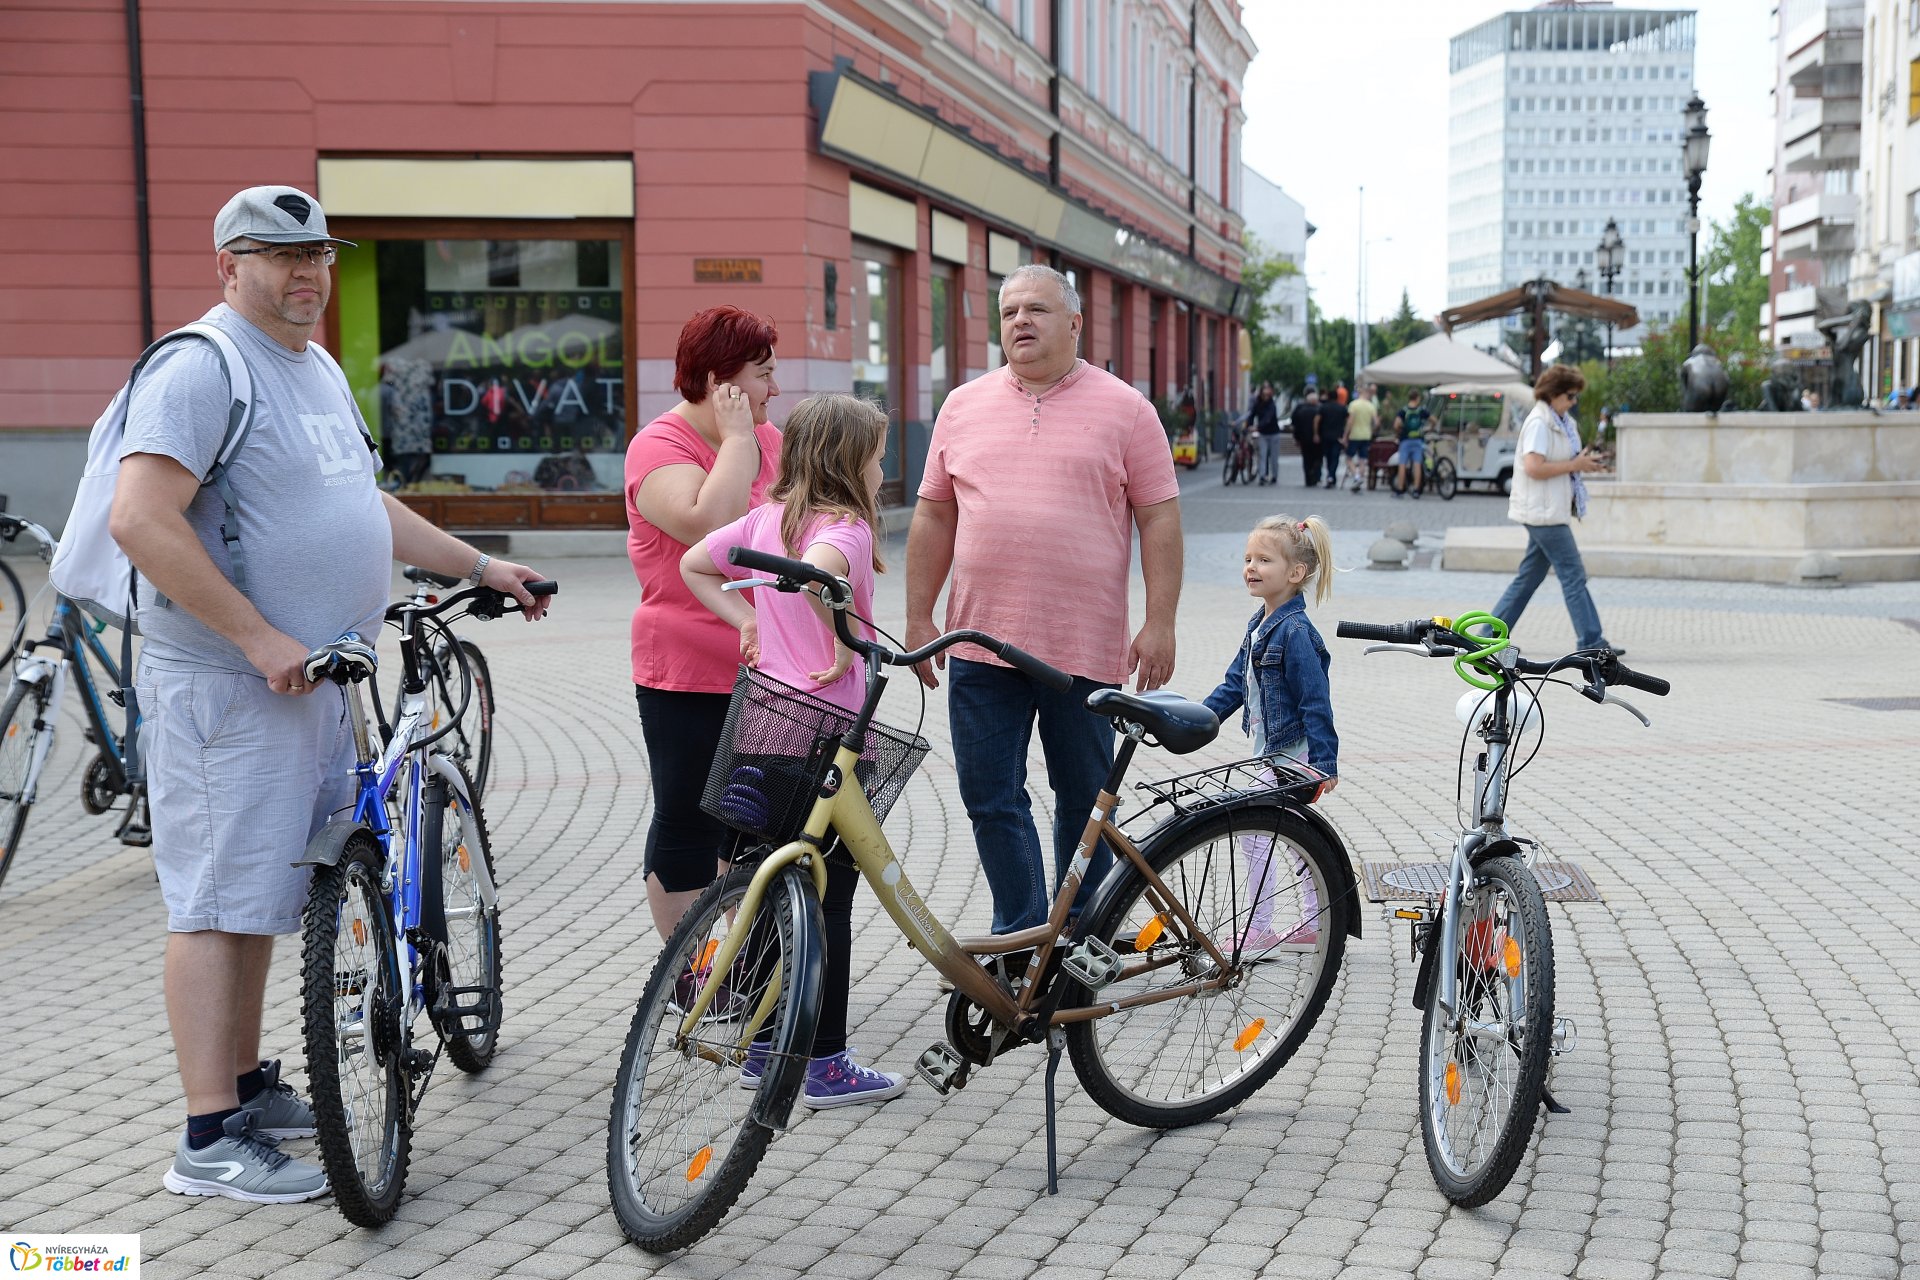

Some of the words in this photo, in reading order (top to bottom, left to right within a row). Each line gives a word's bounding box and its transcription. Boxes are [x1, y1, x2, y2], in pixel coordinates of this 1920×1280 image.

[445, 331, 622, 369] ANGOL
[443, 378, 622, 416] DIVAT
[323, 477, 347, 487] JESUS
